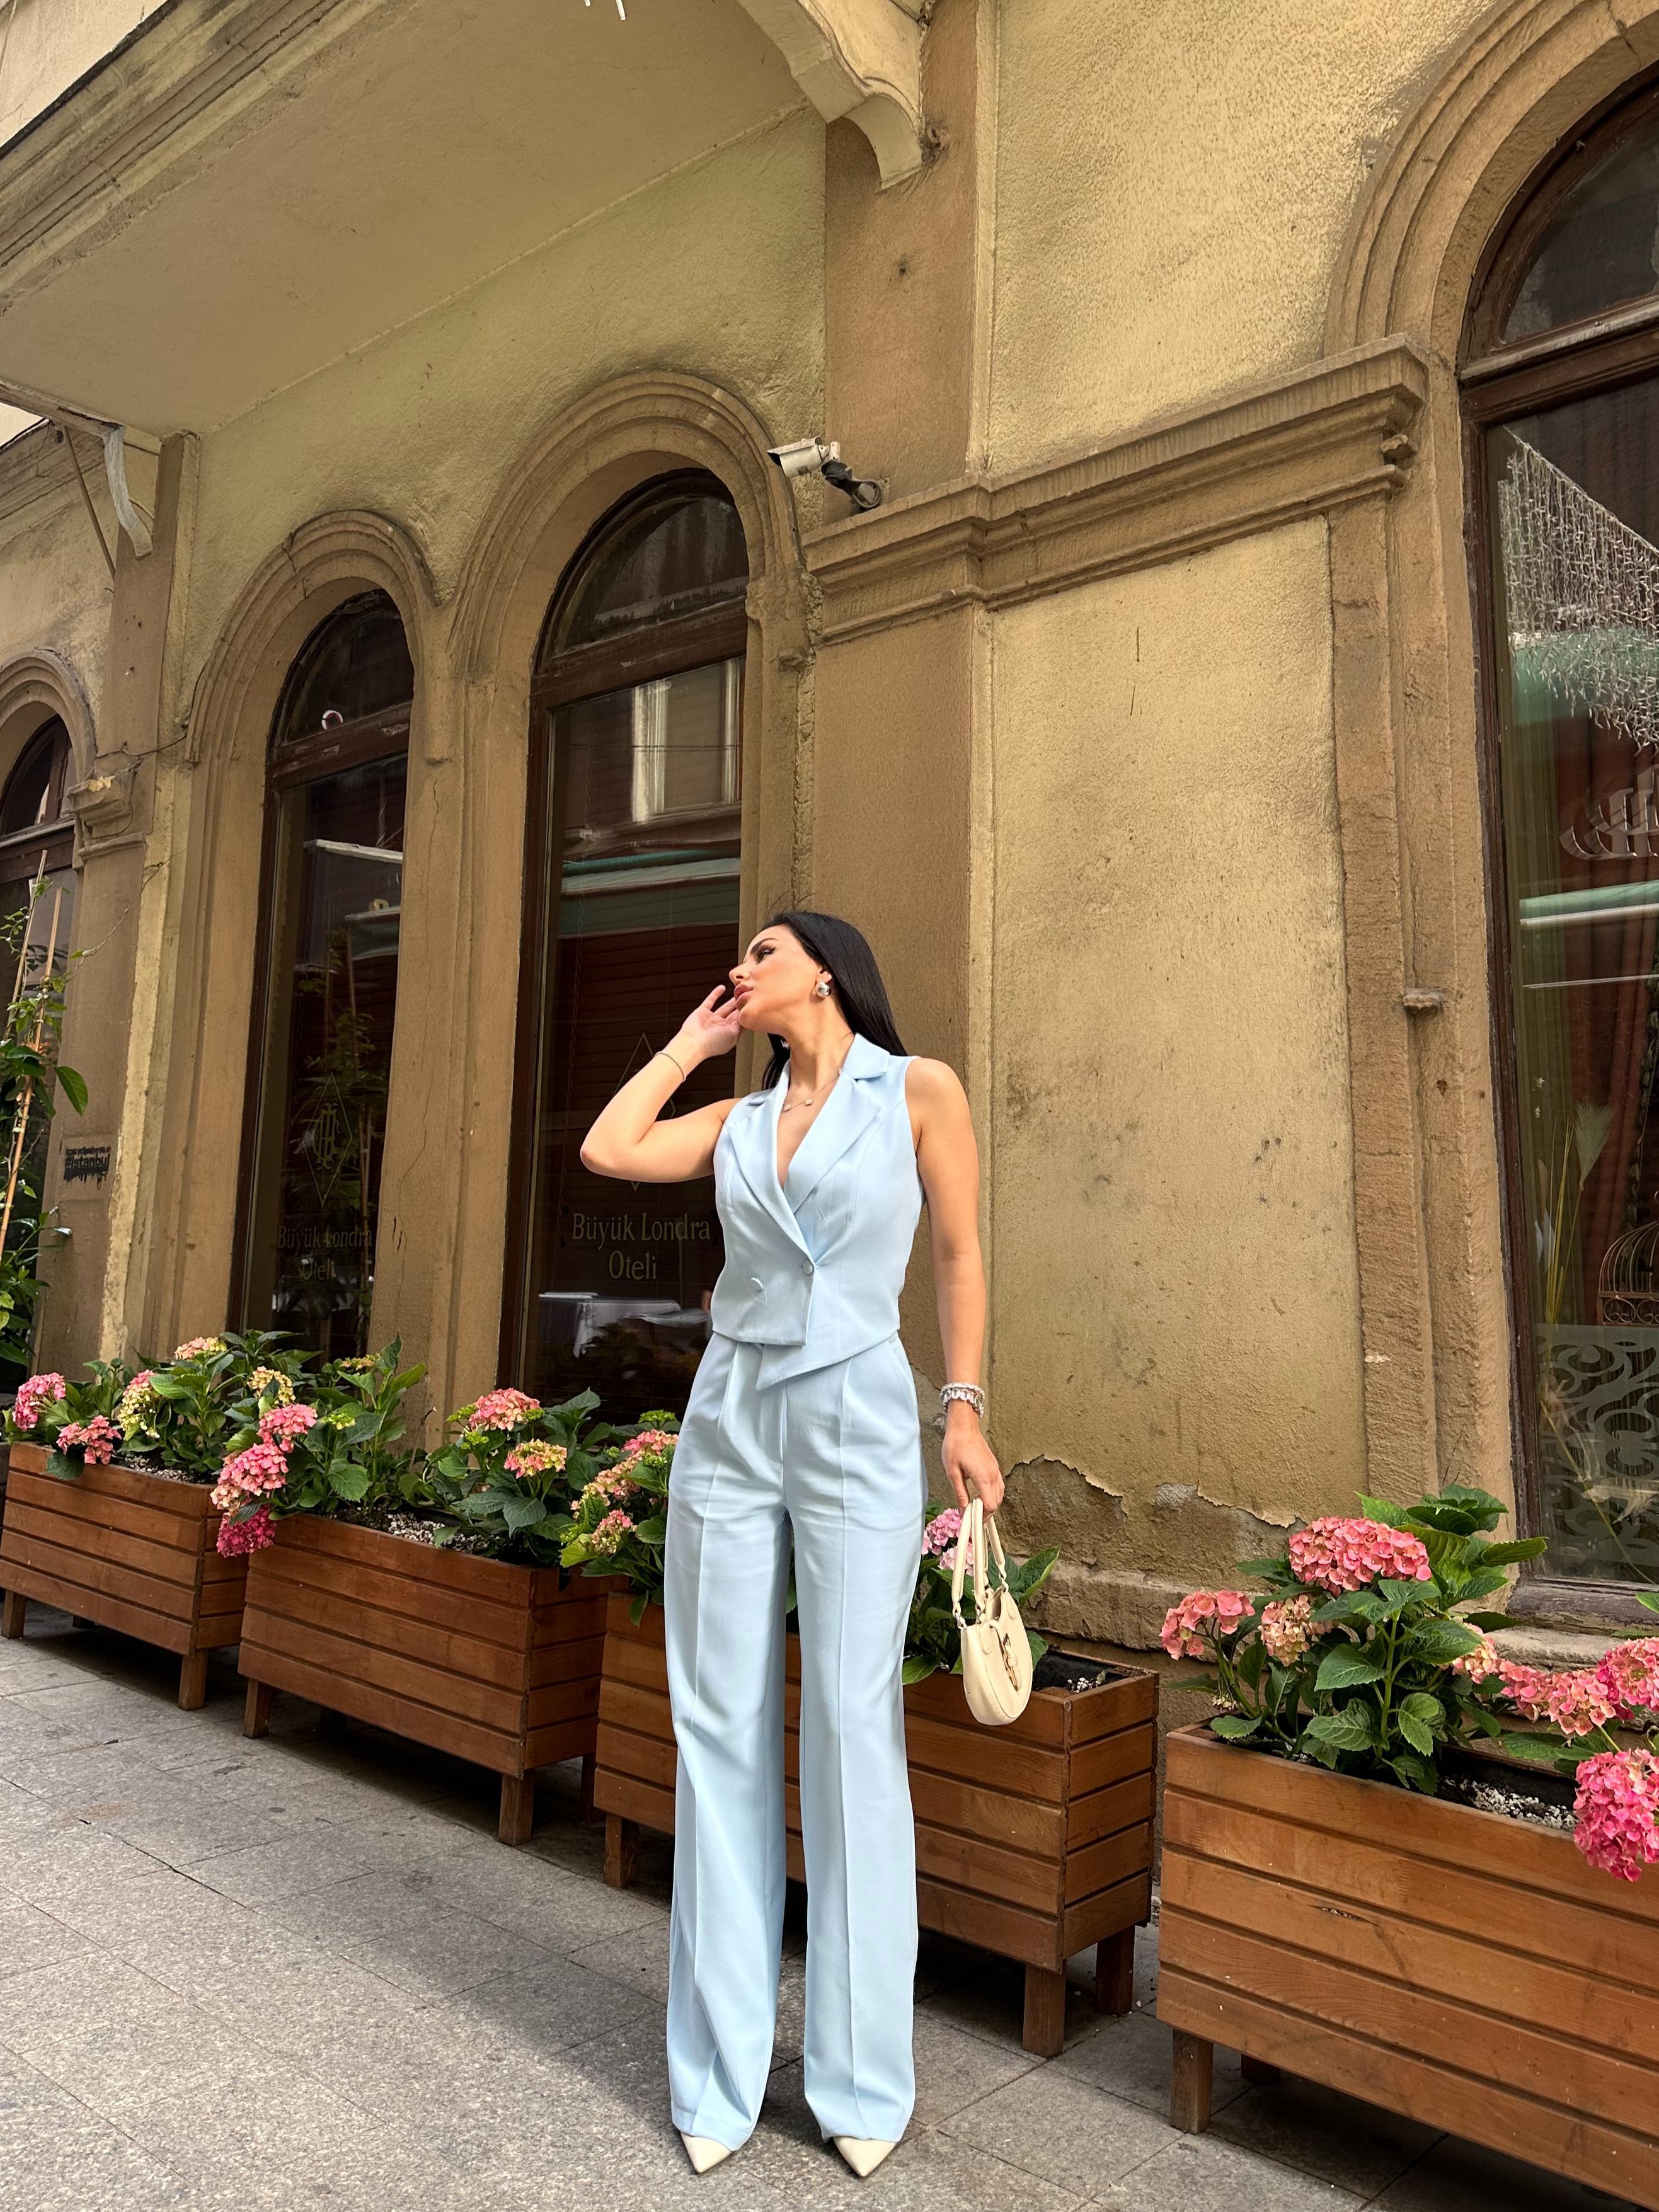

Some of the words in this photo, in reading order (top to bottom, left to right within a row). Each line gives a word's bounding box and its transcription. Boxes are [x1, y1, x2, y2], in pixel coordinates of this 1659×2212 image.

[278, 1225, 322, 1256] Büyük
[324, 1224, 372, 1249] Londra
[571, 1213, 635, 1251] Büyük
[641, 1212, 711, 1241] Londra
[609, 1251, 657, 1280] Oteli
